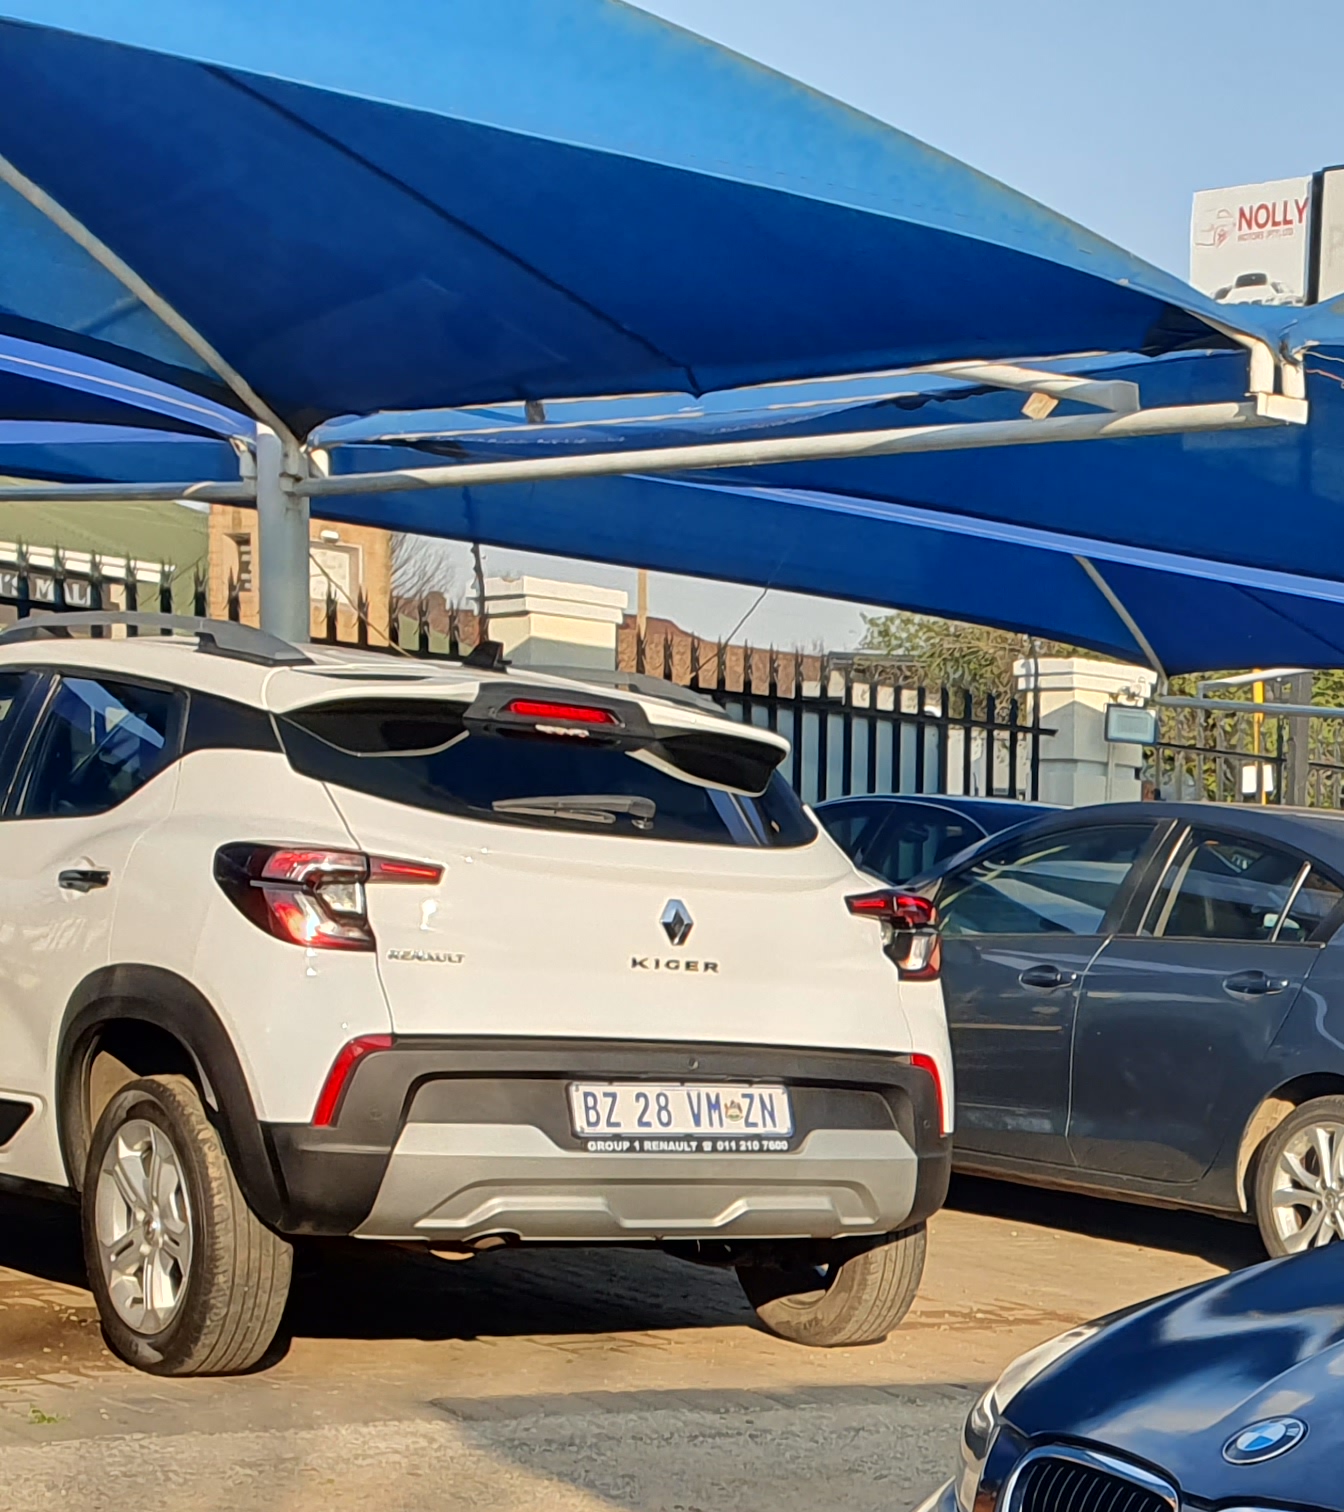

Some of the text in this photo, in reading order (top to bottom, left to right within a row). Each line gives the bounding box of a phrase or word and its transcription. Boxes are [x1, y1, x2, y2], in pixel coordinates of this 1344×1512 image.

[1238, 197, 1309, 231] NOLLY
[387, 949, 467, 964] RENAULT
[631, 957, 719, 974] KIGER
[582, 1091, 778, 1129] BZ 28 VM ZN
[587, 1140, 631, 1151] GROUP
[633, 1140, 640, 1151] 1
[643, 1140, 698, 1152] RENAULT
[717, 1140, 736, 1151] 011
[739, 1140, 760, 1151] 210
